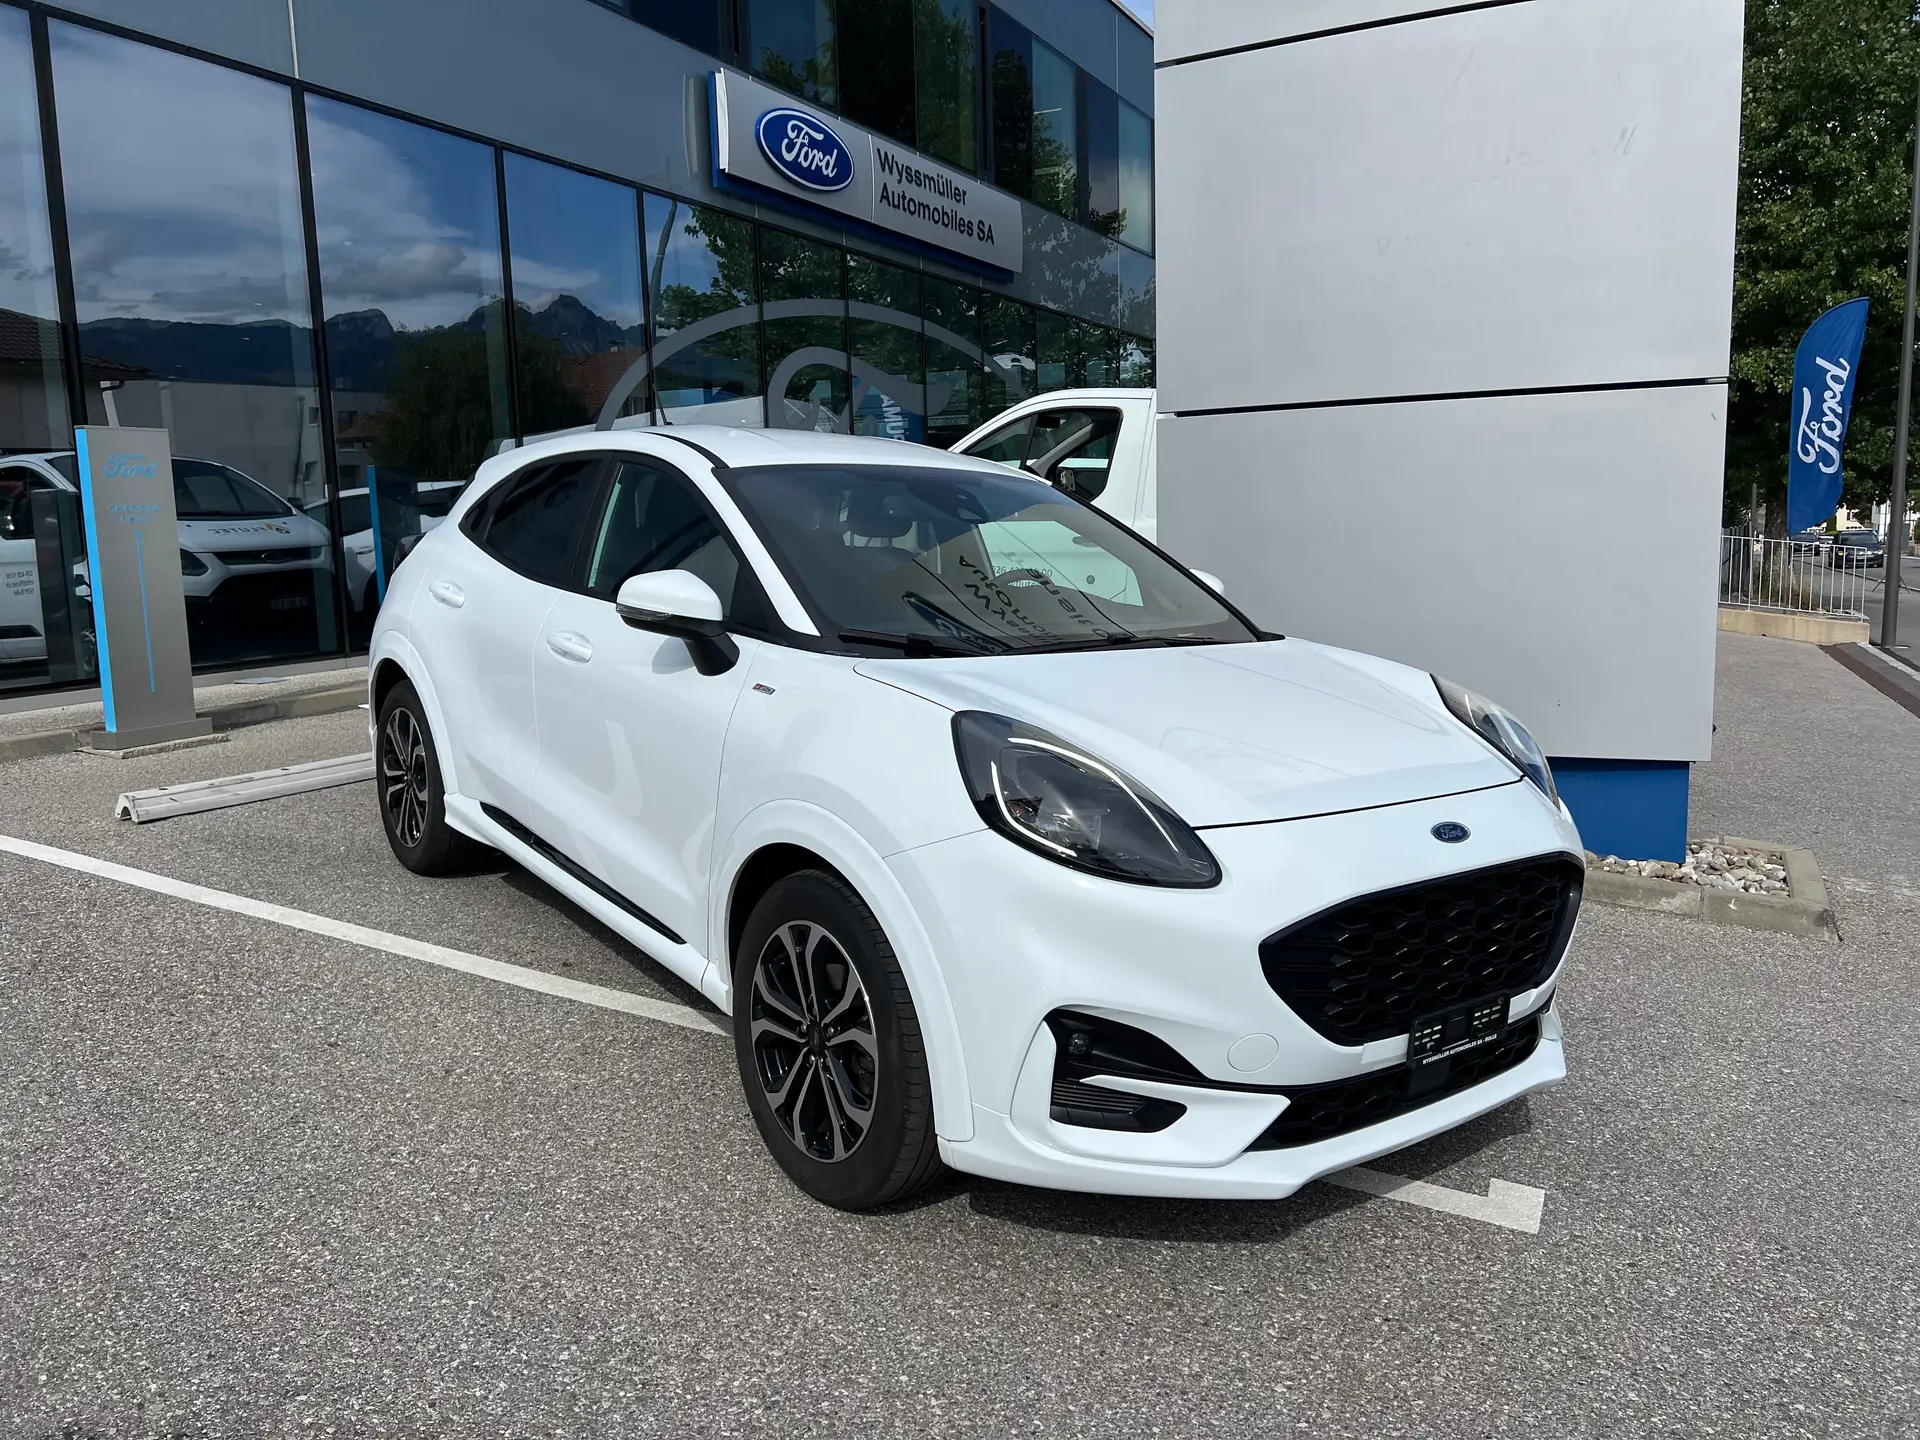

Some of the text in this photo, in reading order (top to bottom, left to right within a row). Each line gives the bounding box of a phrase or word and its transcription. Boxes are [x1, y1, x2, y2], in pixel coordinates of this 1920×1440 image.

[781, 119, 838, 178] Ford
[876, 147, 968, 206] Wyssmüller
[879, 182, 995, 245] Automobiles SA
[1797, 356, 1851, 474] Ford
[103, 453, 159, 478] Ford
[1440, 825, 1464, 839] Ford
